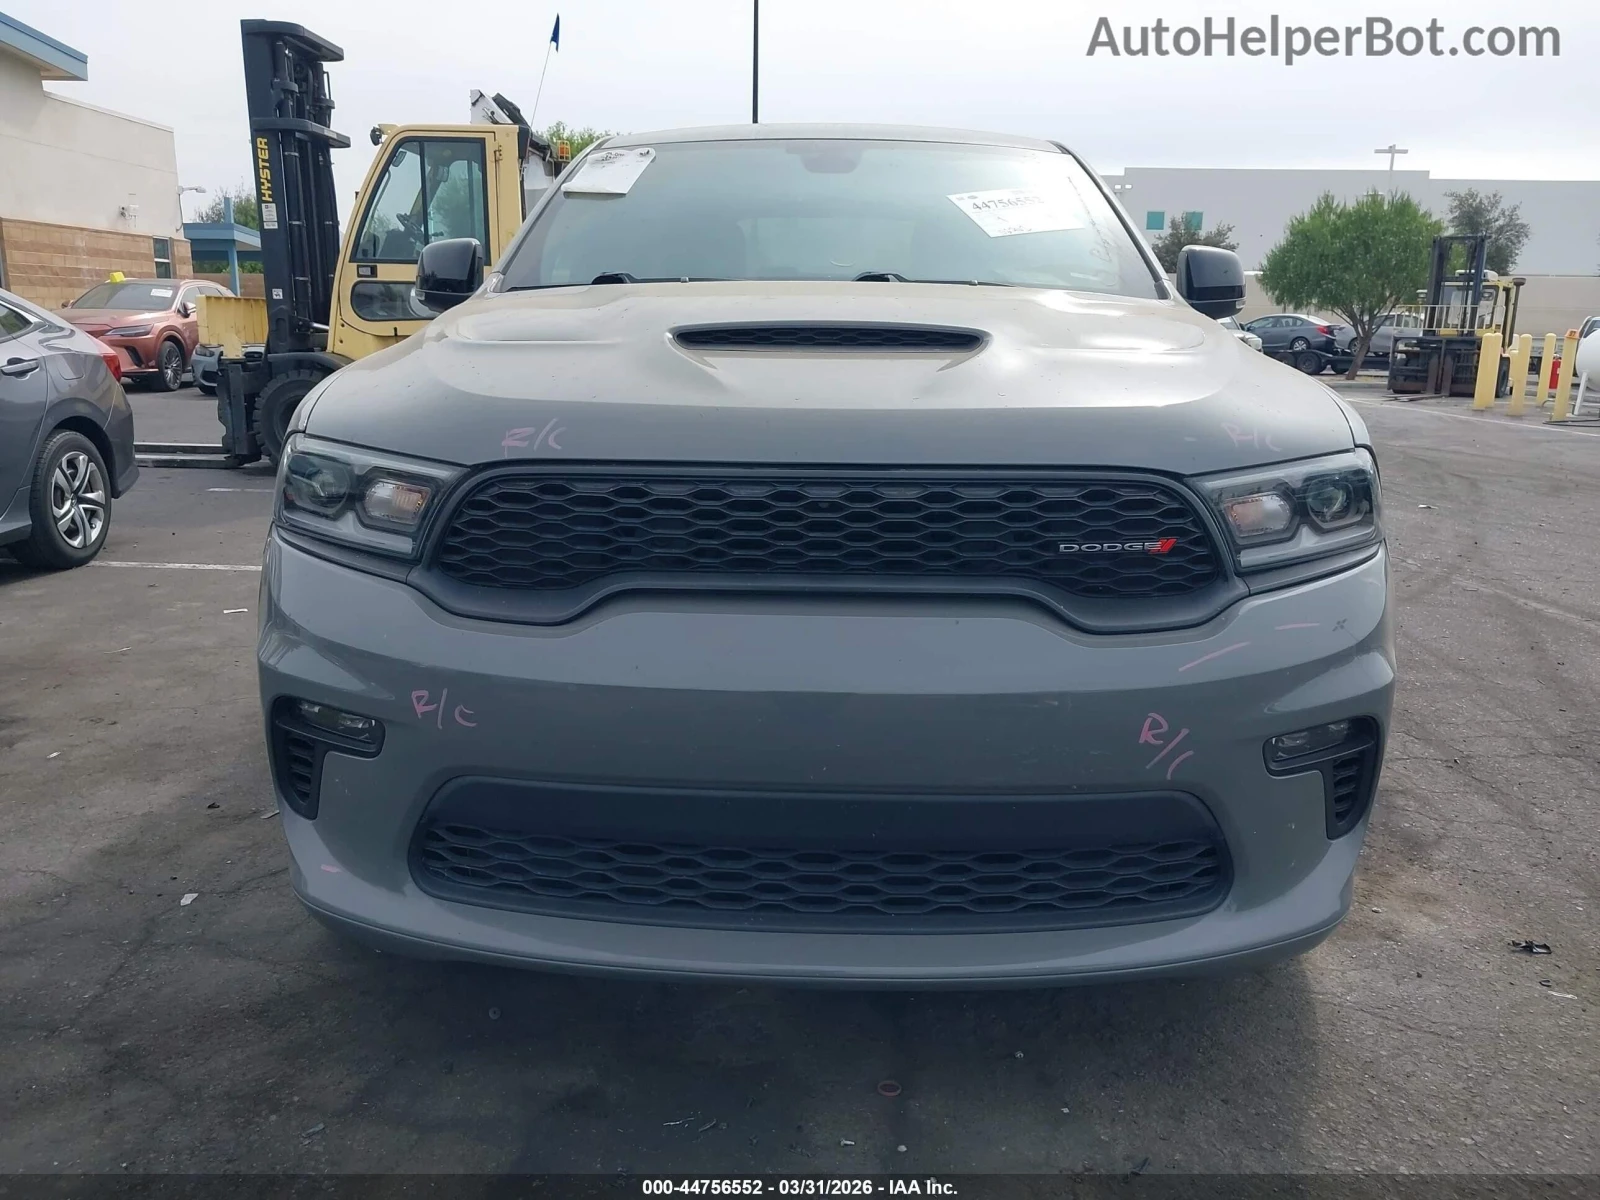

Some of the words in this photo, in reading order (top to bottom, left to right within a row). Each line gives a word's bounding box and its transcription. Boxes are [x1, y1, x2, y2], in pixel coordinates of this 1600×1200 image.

[256, 137, 273, 202] HYSTER
[972, 196, 1044, 211] 44756552
[1059, 542, 1162, 552] DODGE
